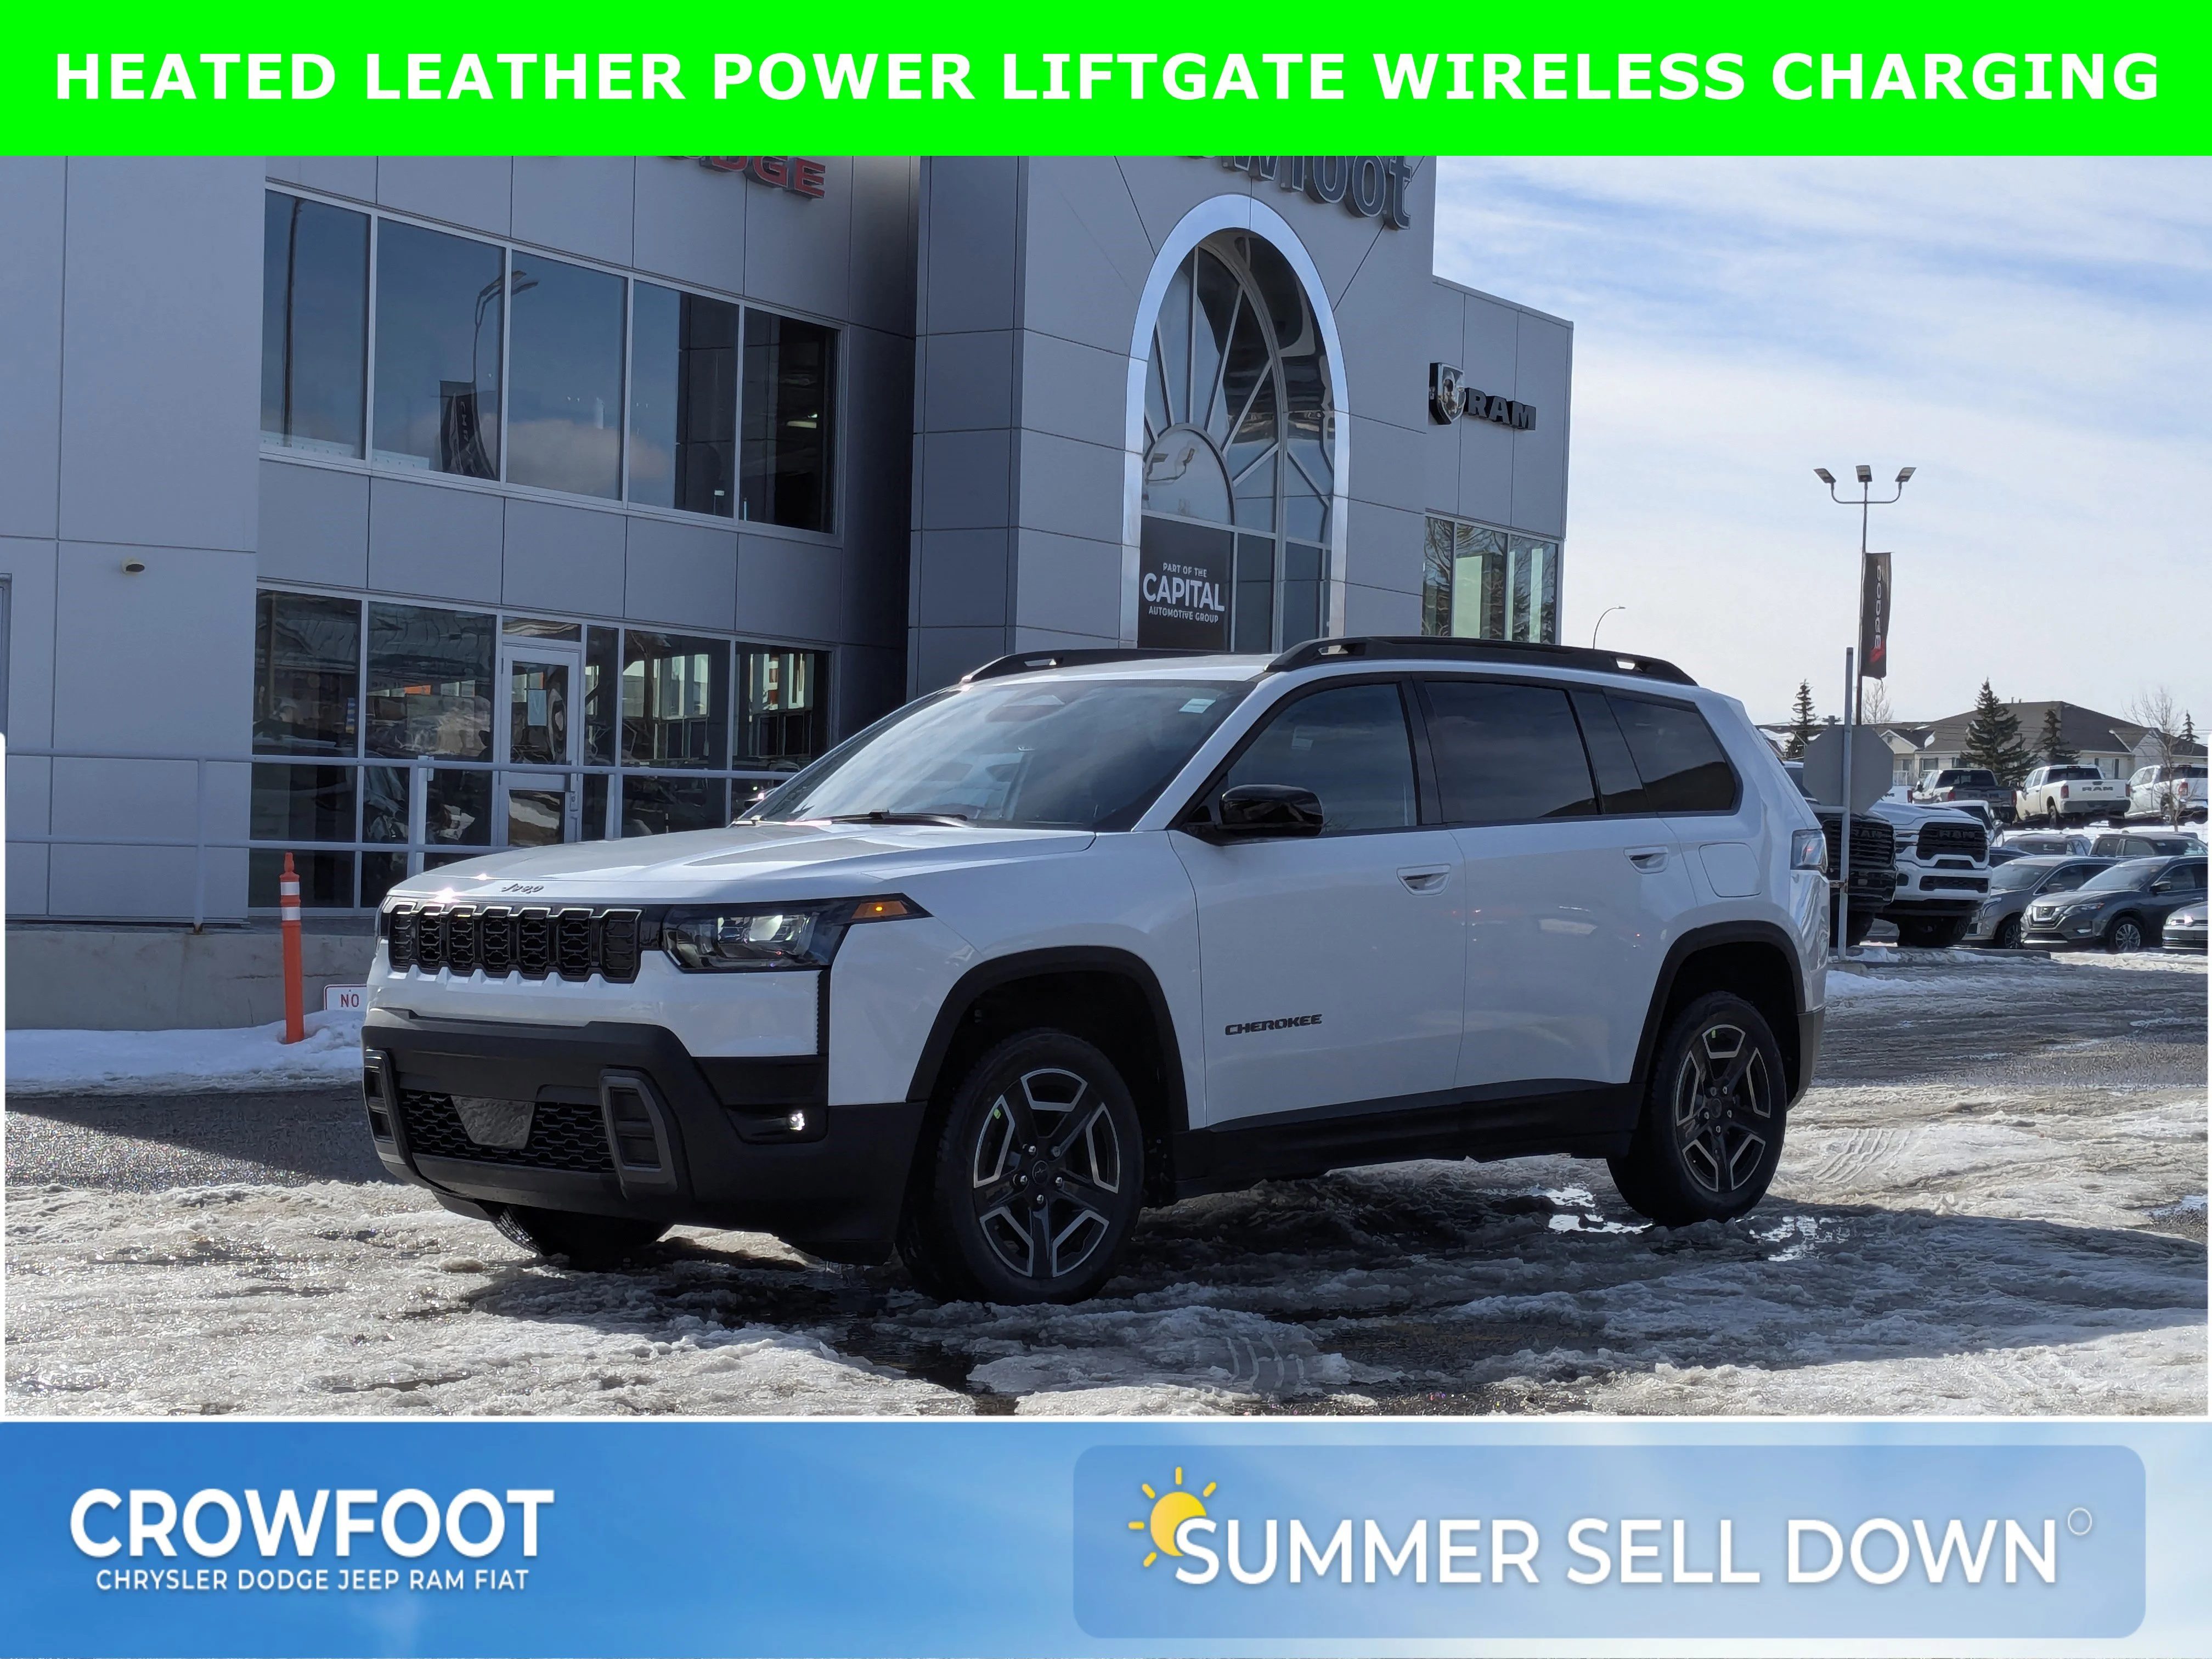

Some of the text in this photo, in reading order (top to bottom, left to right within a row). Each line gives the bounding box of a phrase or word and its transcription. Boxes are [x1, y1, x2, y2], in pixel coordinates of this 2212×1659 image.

[1466, 387, 1537, 431] RAM
[1163, 562, 1207, 578] PART OF THE
[1143, 573, 1225, 612] CAPITAL
[1148, 606, 1219, 623] AUTOMOTIVE GROUP
[340, 994, 359, 1008] NO
[1225, 1013, 1322, 1036] CHEROKEE
